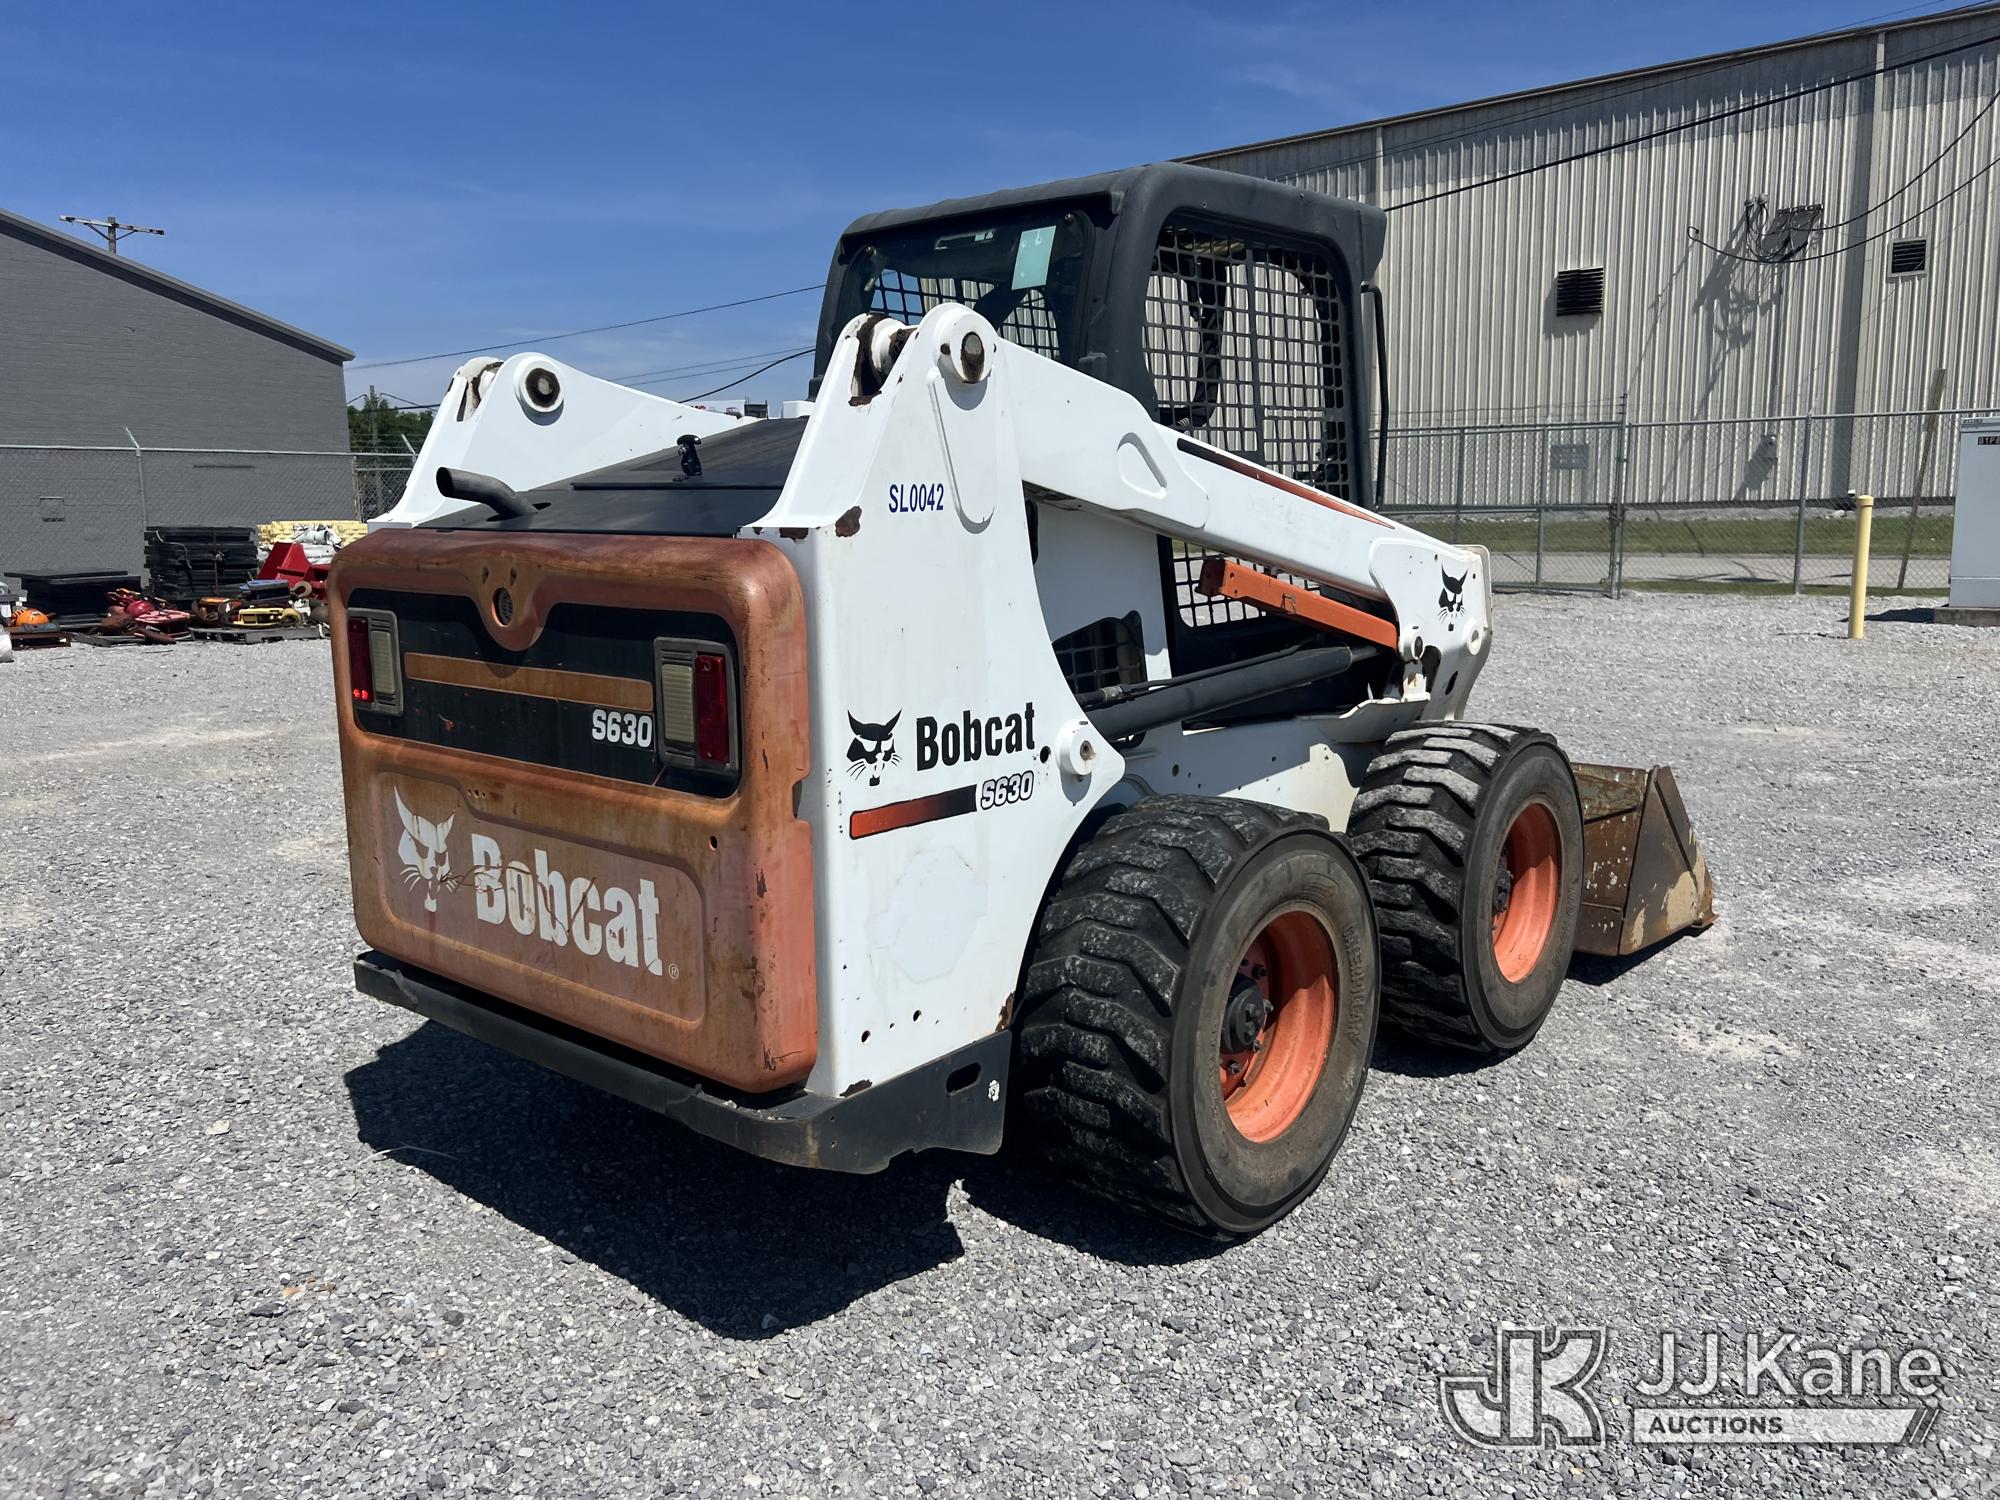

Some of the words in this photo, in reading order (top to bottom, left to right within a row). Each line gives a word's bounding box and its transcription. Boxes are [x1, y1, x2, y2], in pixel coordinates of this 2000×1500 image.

[888, 483, 944, 513] SL0042
[591, 708, 653, 748] S630
[916, 702, 1035, 771] Bobcat
[980, 770, 1034, 810] S630
[471, 833, 664, 976] Bobcat
